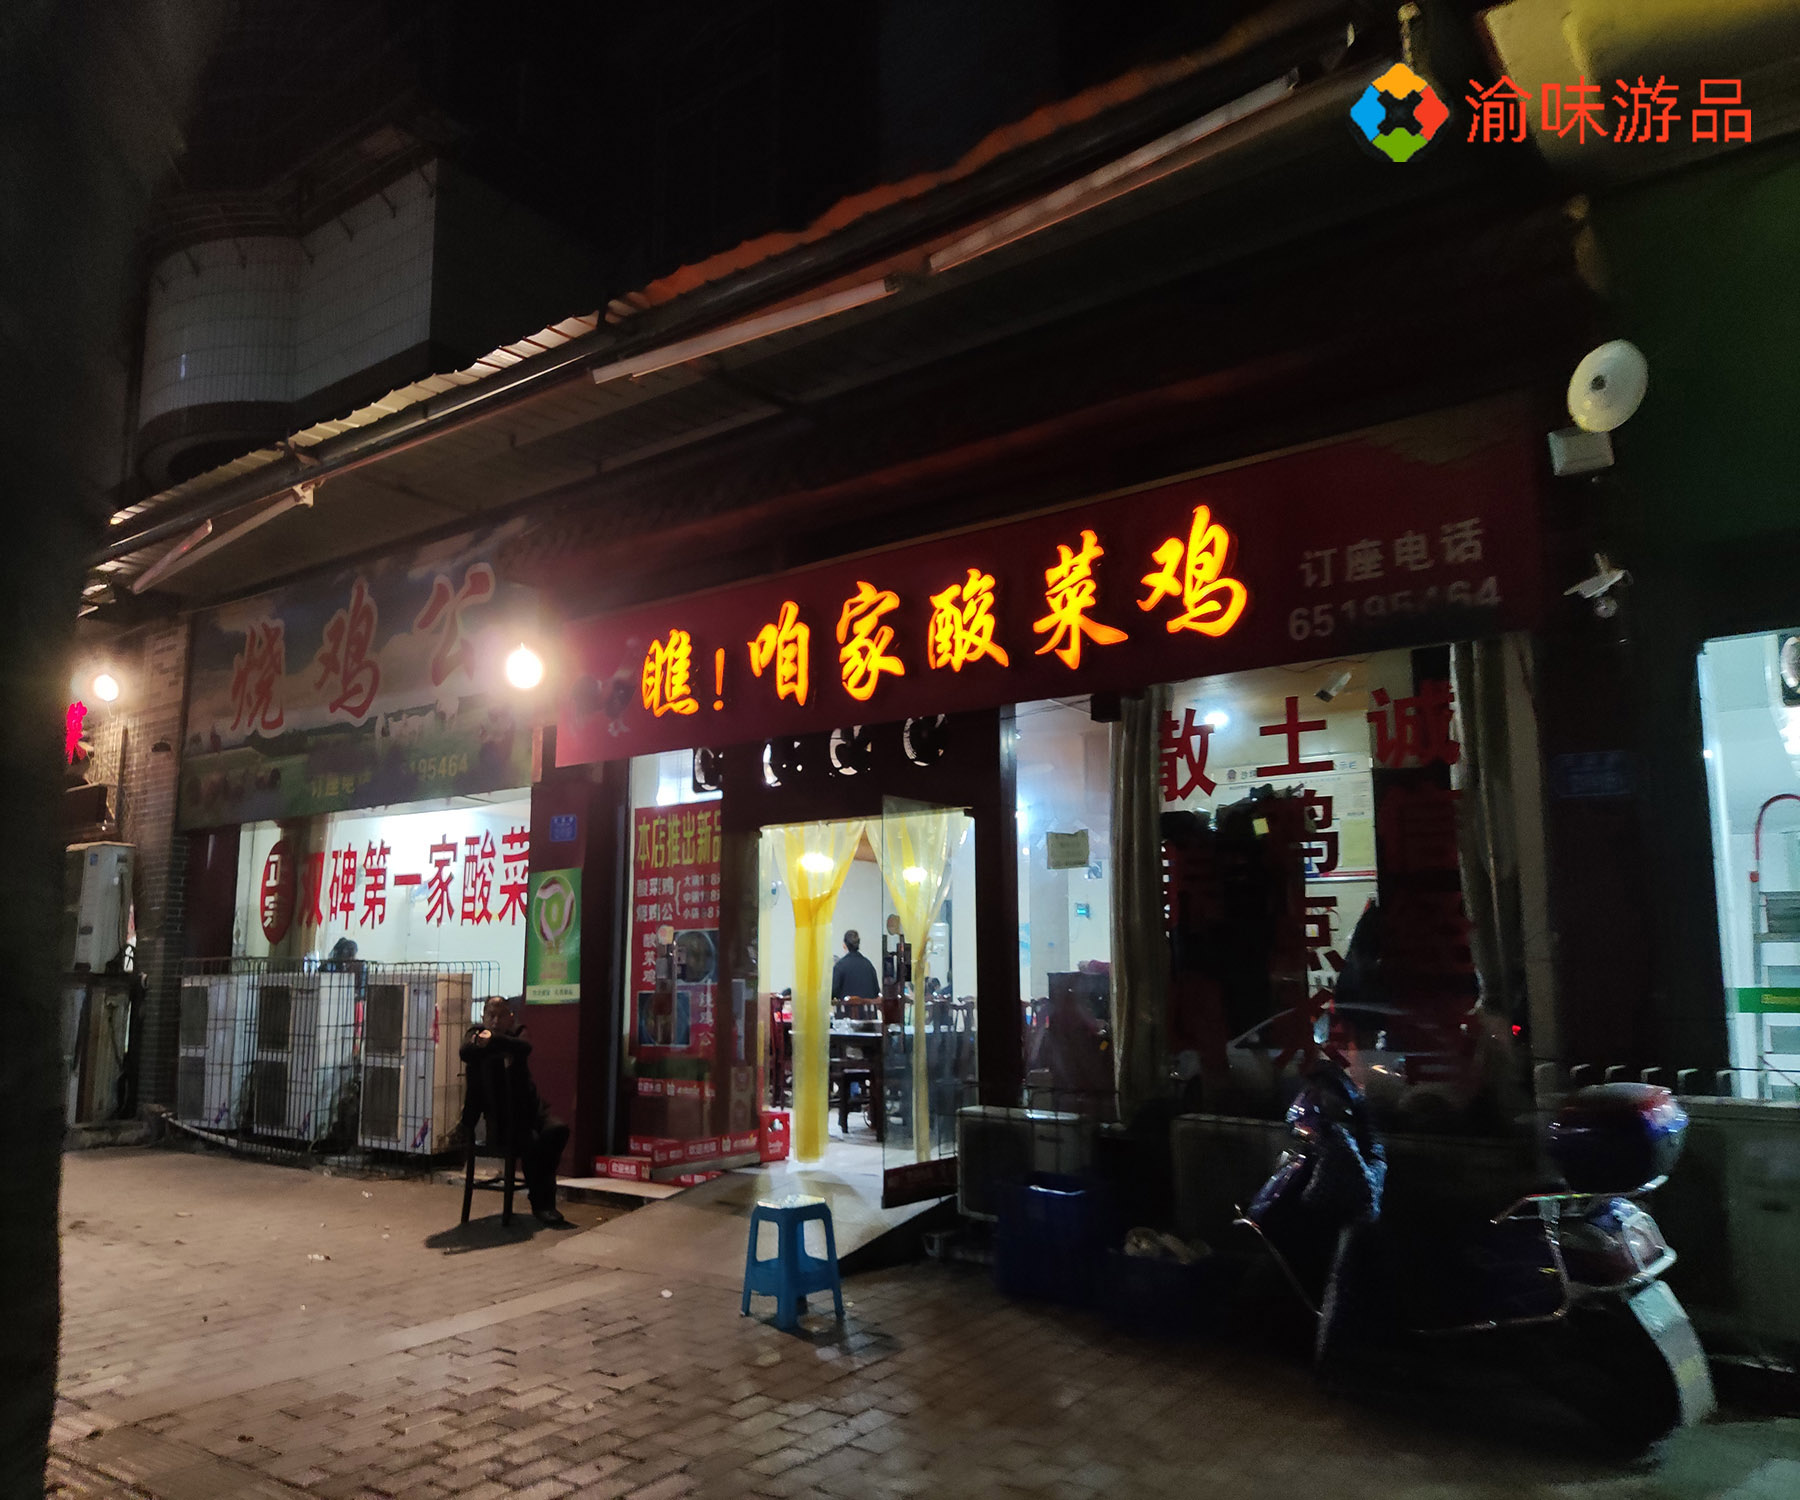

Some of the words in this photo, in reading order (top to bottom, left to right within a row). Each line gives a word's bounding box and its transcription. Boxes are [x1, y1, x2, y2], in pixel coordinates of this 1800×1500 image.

[1298, 516, 1485, 588] 订座电话
[229, 562, 495, 737] 烧鸡公
